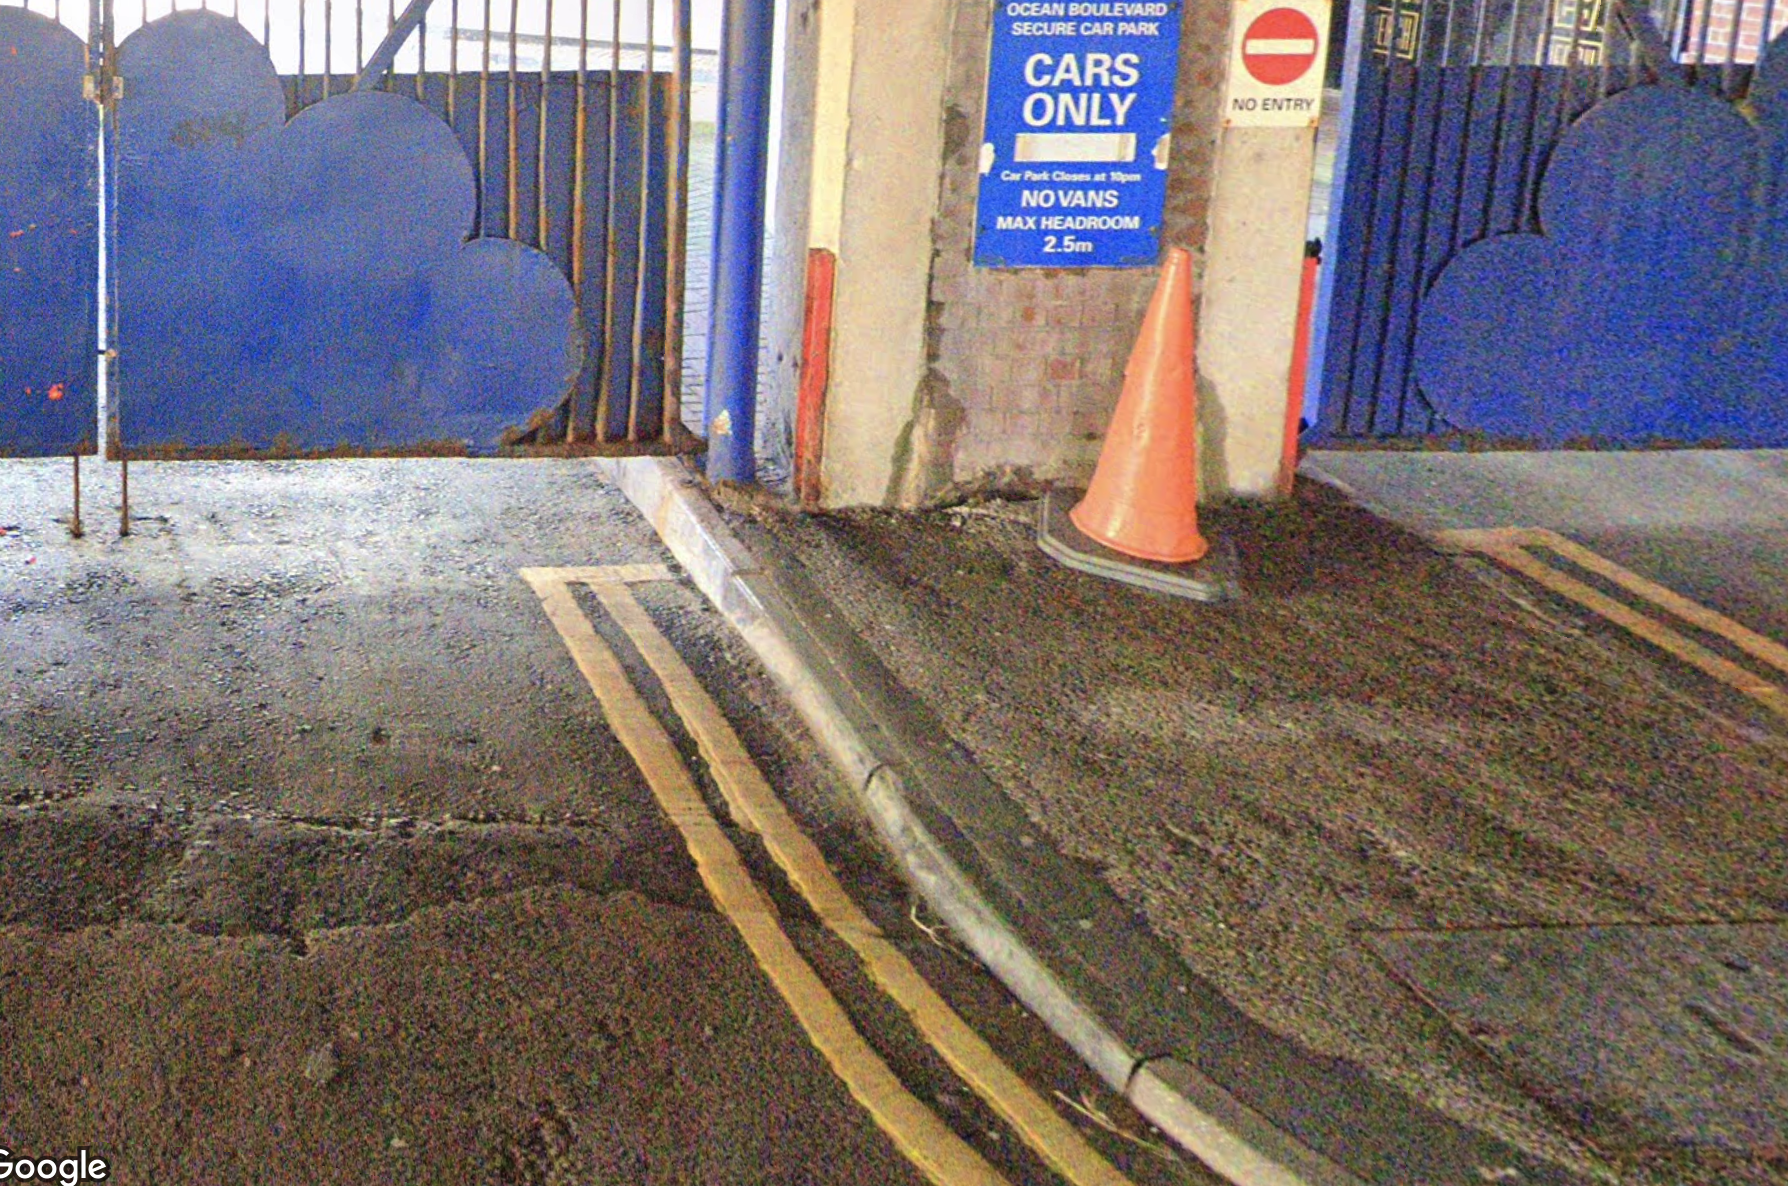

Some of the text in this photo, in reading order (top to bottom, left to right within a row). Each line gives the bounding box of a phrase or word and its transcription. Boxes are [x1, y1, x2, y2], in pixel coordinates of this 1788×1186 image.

[1007, 2, 1168, 16] OCEAN BOULEVARD
[1012, 22, 1159, 36] SECURE CAR PARK
[1023, 53, 1140, 87] CARS
[1022, 93, 1137, 127] ONLY
[1232, 98, 1315, 111] NO ENTRY
[1000, 170, 1022, 181] Car
[1024, 170, 1049, 181] Park
[1052, 171, 1091, 181] Closes
[1093, 172, 1107, 182] at
[1021, 190, 1119, 209] NO VANS
[996, 216, 1140, 230] MAX HEADROOM
[1043, 236, 1093, 253] 2.5m
